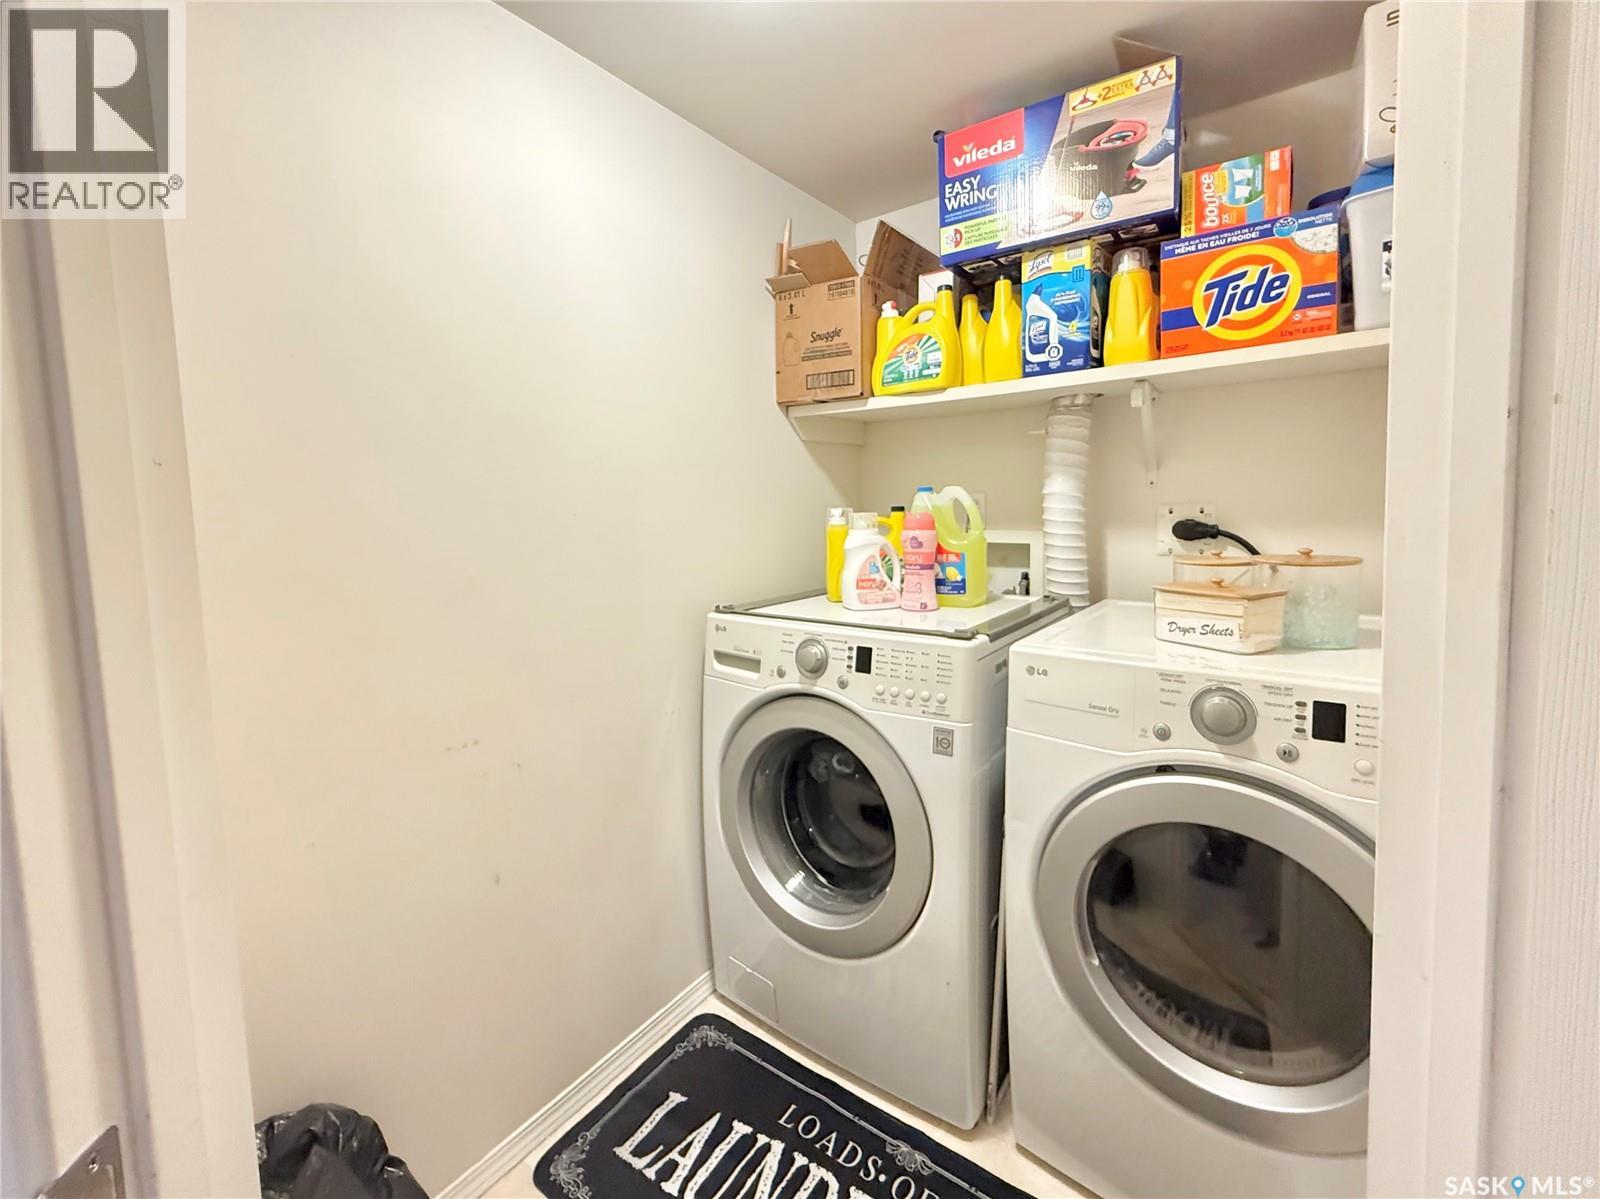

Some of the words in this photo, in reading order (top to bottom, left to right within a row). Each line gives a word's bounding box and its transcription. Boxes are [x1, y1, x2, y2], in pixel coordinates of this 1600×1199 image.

[952, 136, 1017, 169] vileda
[1069, 162, 1099, 172] vileda
[945, 175, 981, 198] EASY
[945, 184, 997, 212] WRING
[1200, 172, 1219, 228] bounce
[1197, 242, 1209, 250] EN
[1209, 239, 1226, 248] EAU
[1226, 231, 1260, 245] FROIDE!
[1203, 265, 1291, 329] Tide
[810, 328, 843, 344] Snuggle
[1167, 620, 1196, 638] Dryer
[1199, 623, 1235, 638] Sheets
[1087, 702, 1107, 712] Sensor
[1108, 705, 1120, 715] Dry
[778, 1103, 883, 1182] LOADS
